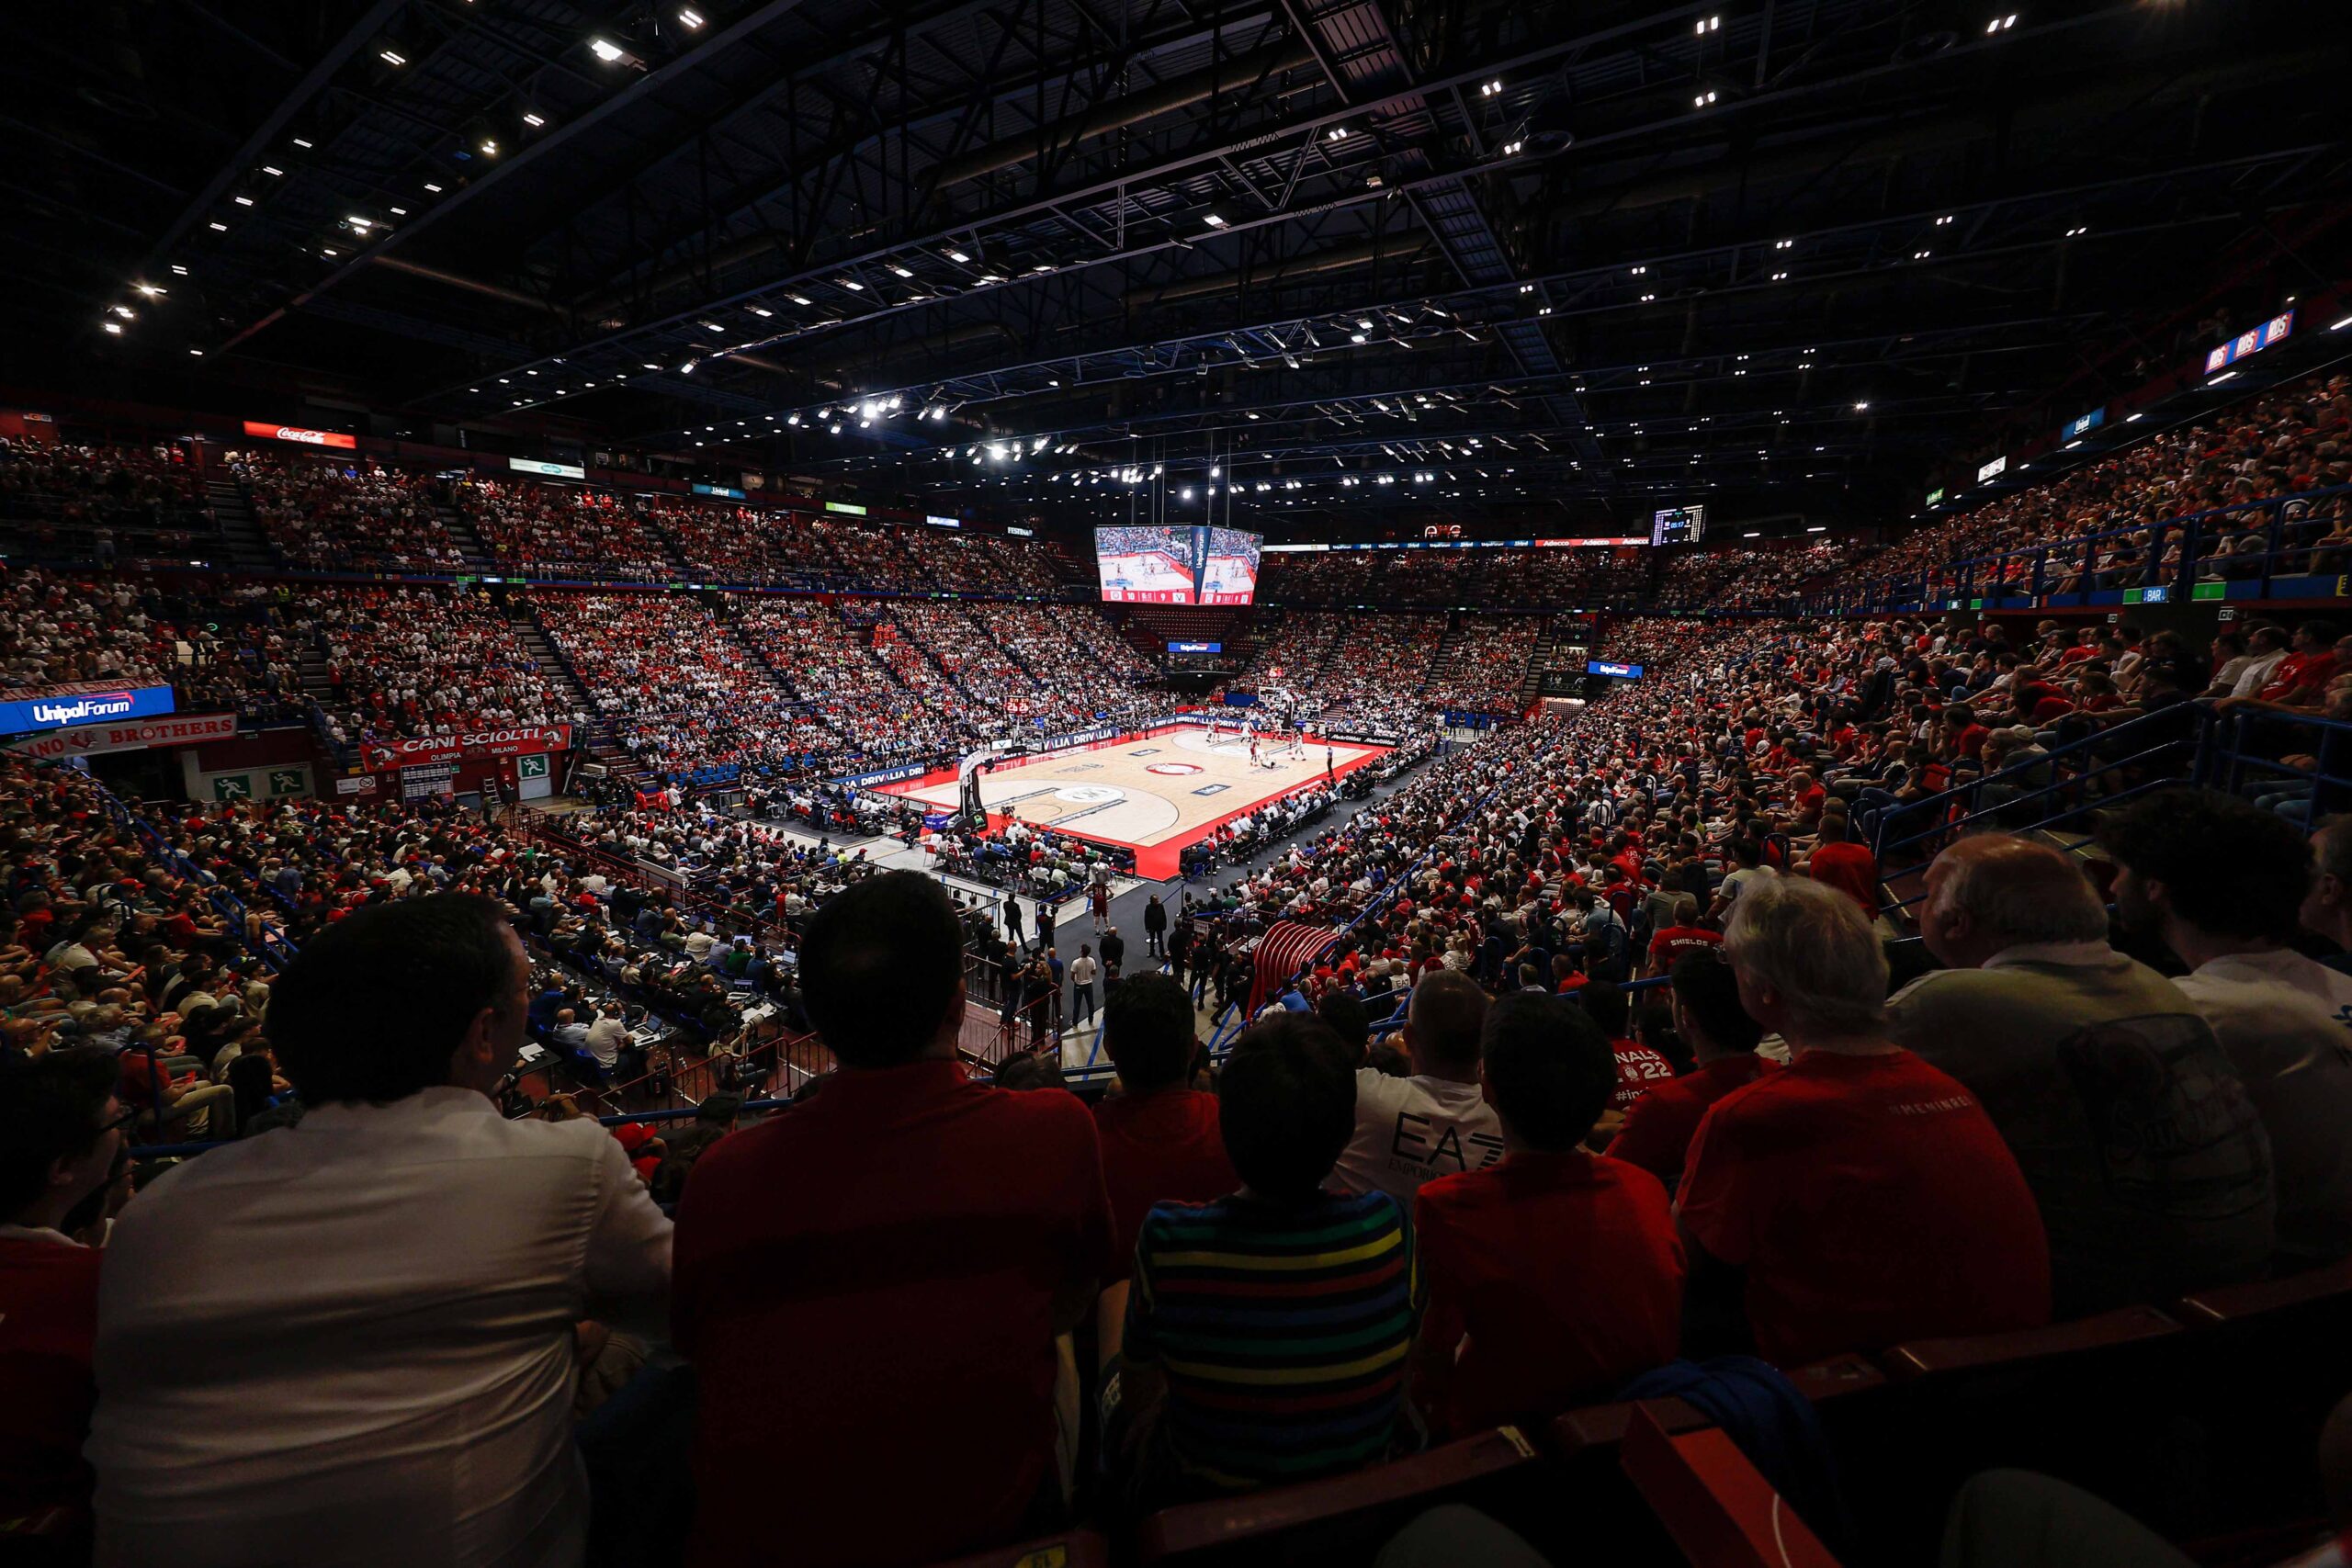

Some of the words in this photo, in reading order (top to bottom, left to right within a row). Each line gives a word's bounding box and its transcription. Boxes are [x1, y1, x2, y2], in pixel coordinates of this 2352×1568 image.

[1196, 535, 1204, 569] UnipolForum
[2147, 589, 2162, 601] BAR
[33, 699, 130, 724] UnipolForum
[110, 719, 233, 744] BROTHERS
[403, 738, 456, 752] CANI
[461, 727, 539, 746] SCIOLTI
[1074, 728, 1113, 745] DRIVALIA
[431, 751, 462, 761] OLIMPIA
[492, 745, 518, 754] MILANO
[861, 768, 905, 787] DRIVALIA
[1670, 938, 1709, 947] SHIELDS
[1613, 1050, 1660, 1065] NALS
[1392, 1111, 1504, 1172] EA7
